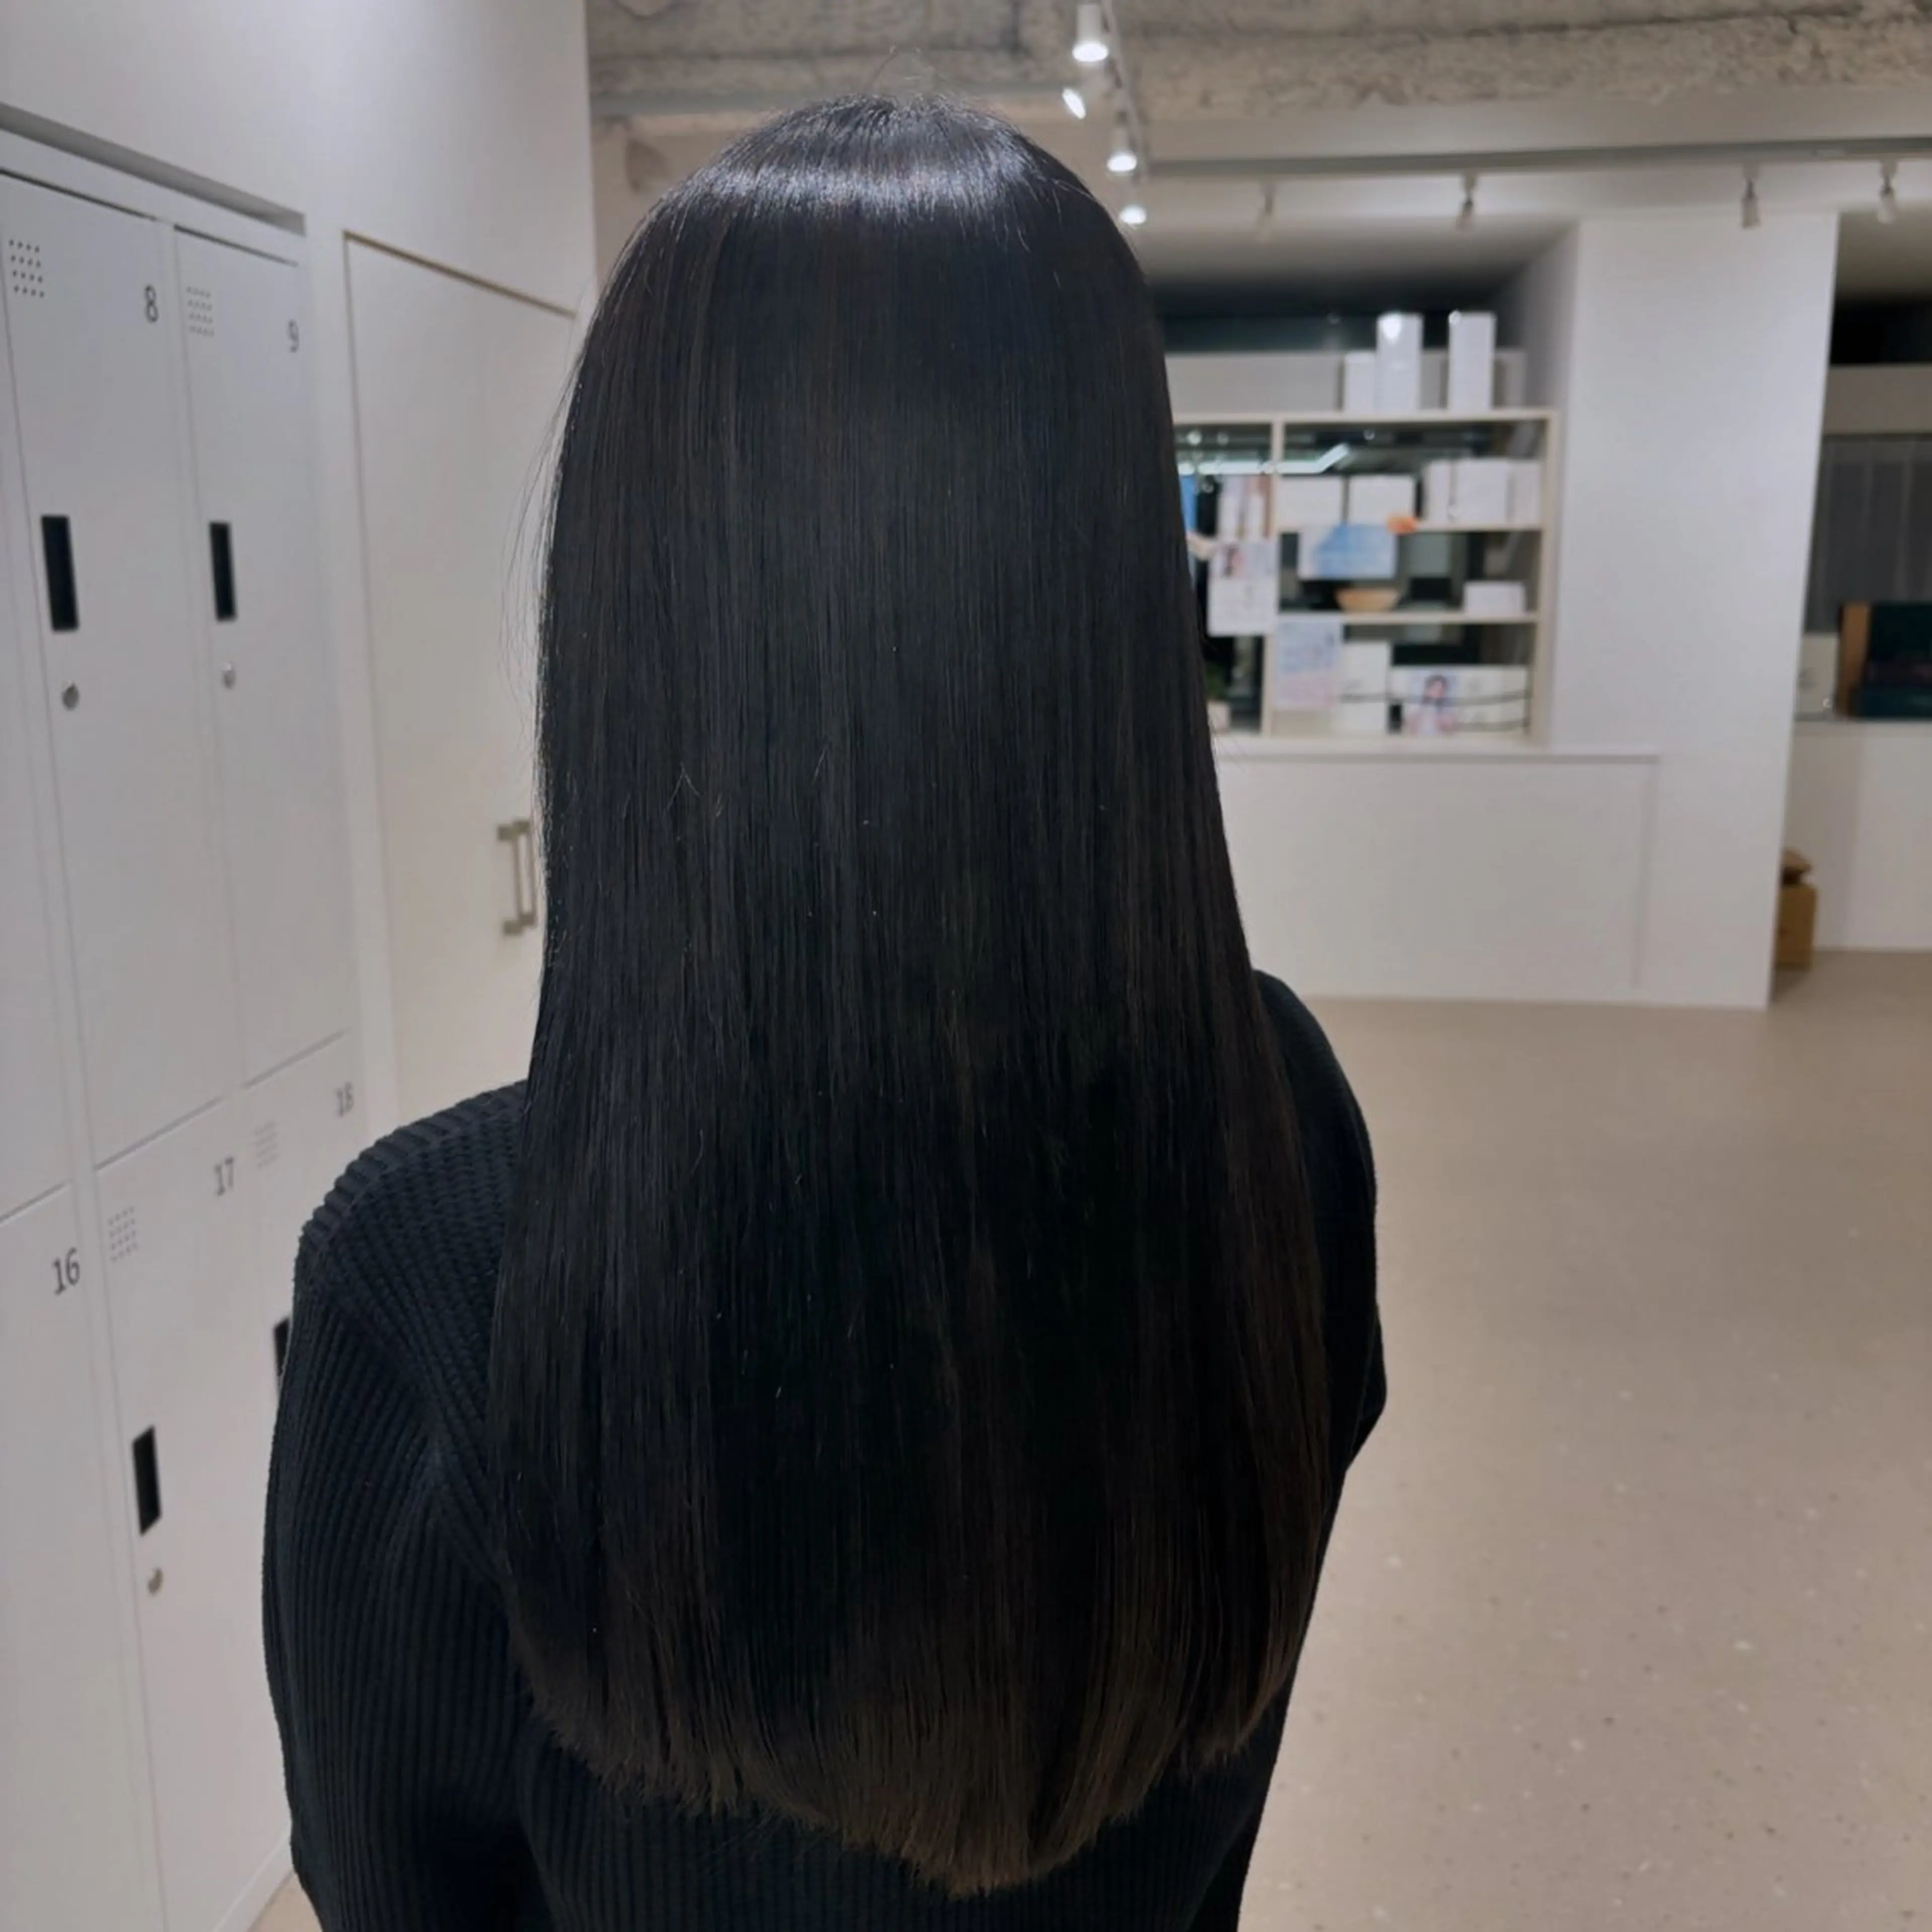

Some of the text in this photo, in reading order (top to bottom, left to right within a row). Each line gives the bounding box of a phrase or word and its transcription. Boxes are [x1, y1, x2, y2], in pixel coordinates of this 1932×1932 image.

[144, 285, 158, 323] 8
[288, 319, 299, 353] 9
[214, 1157, 234, 1196] 17
[52, 1248, 80, 1296] 16
